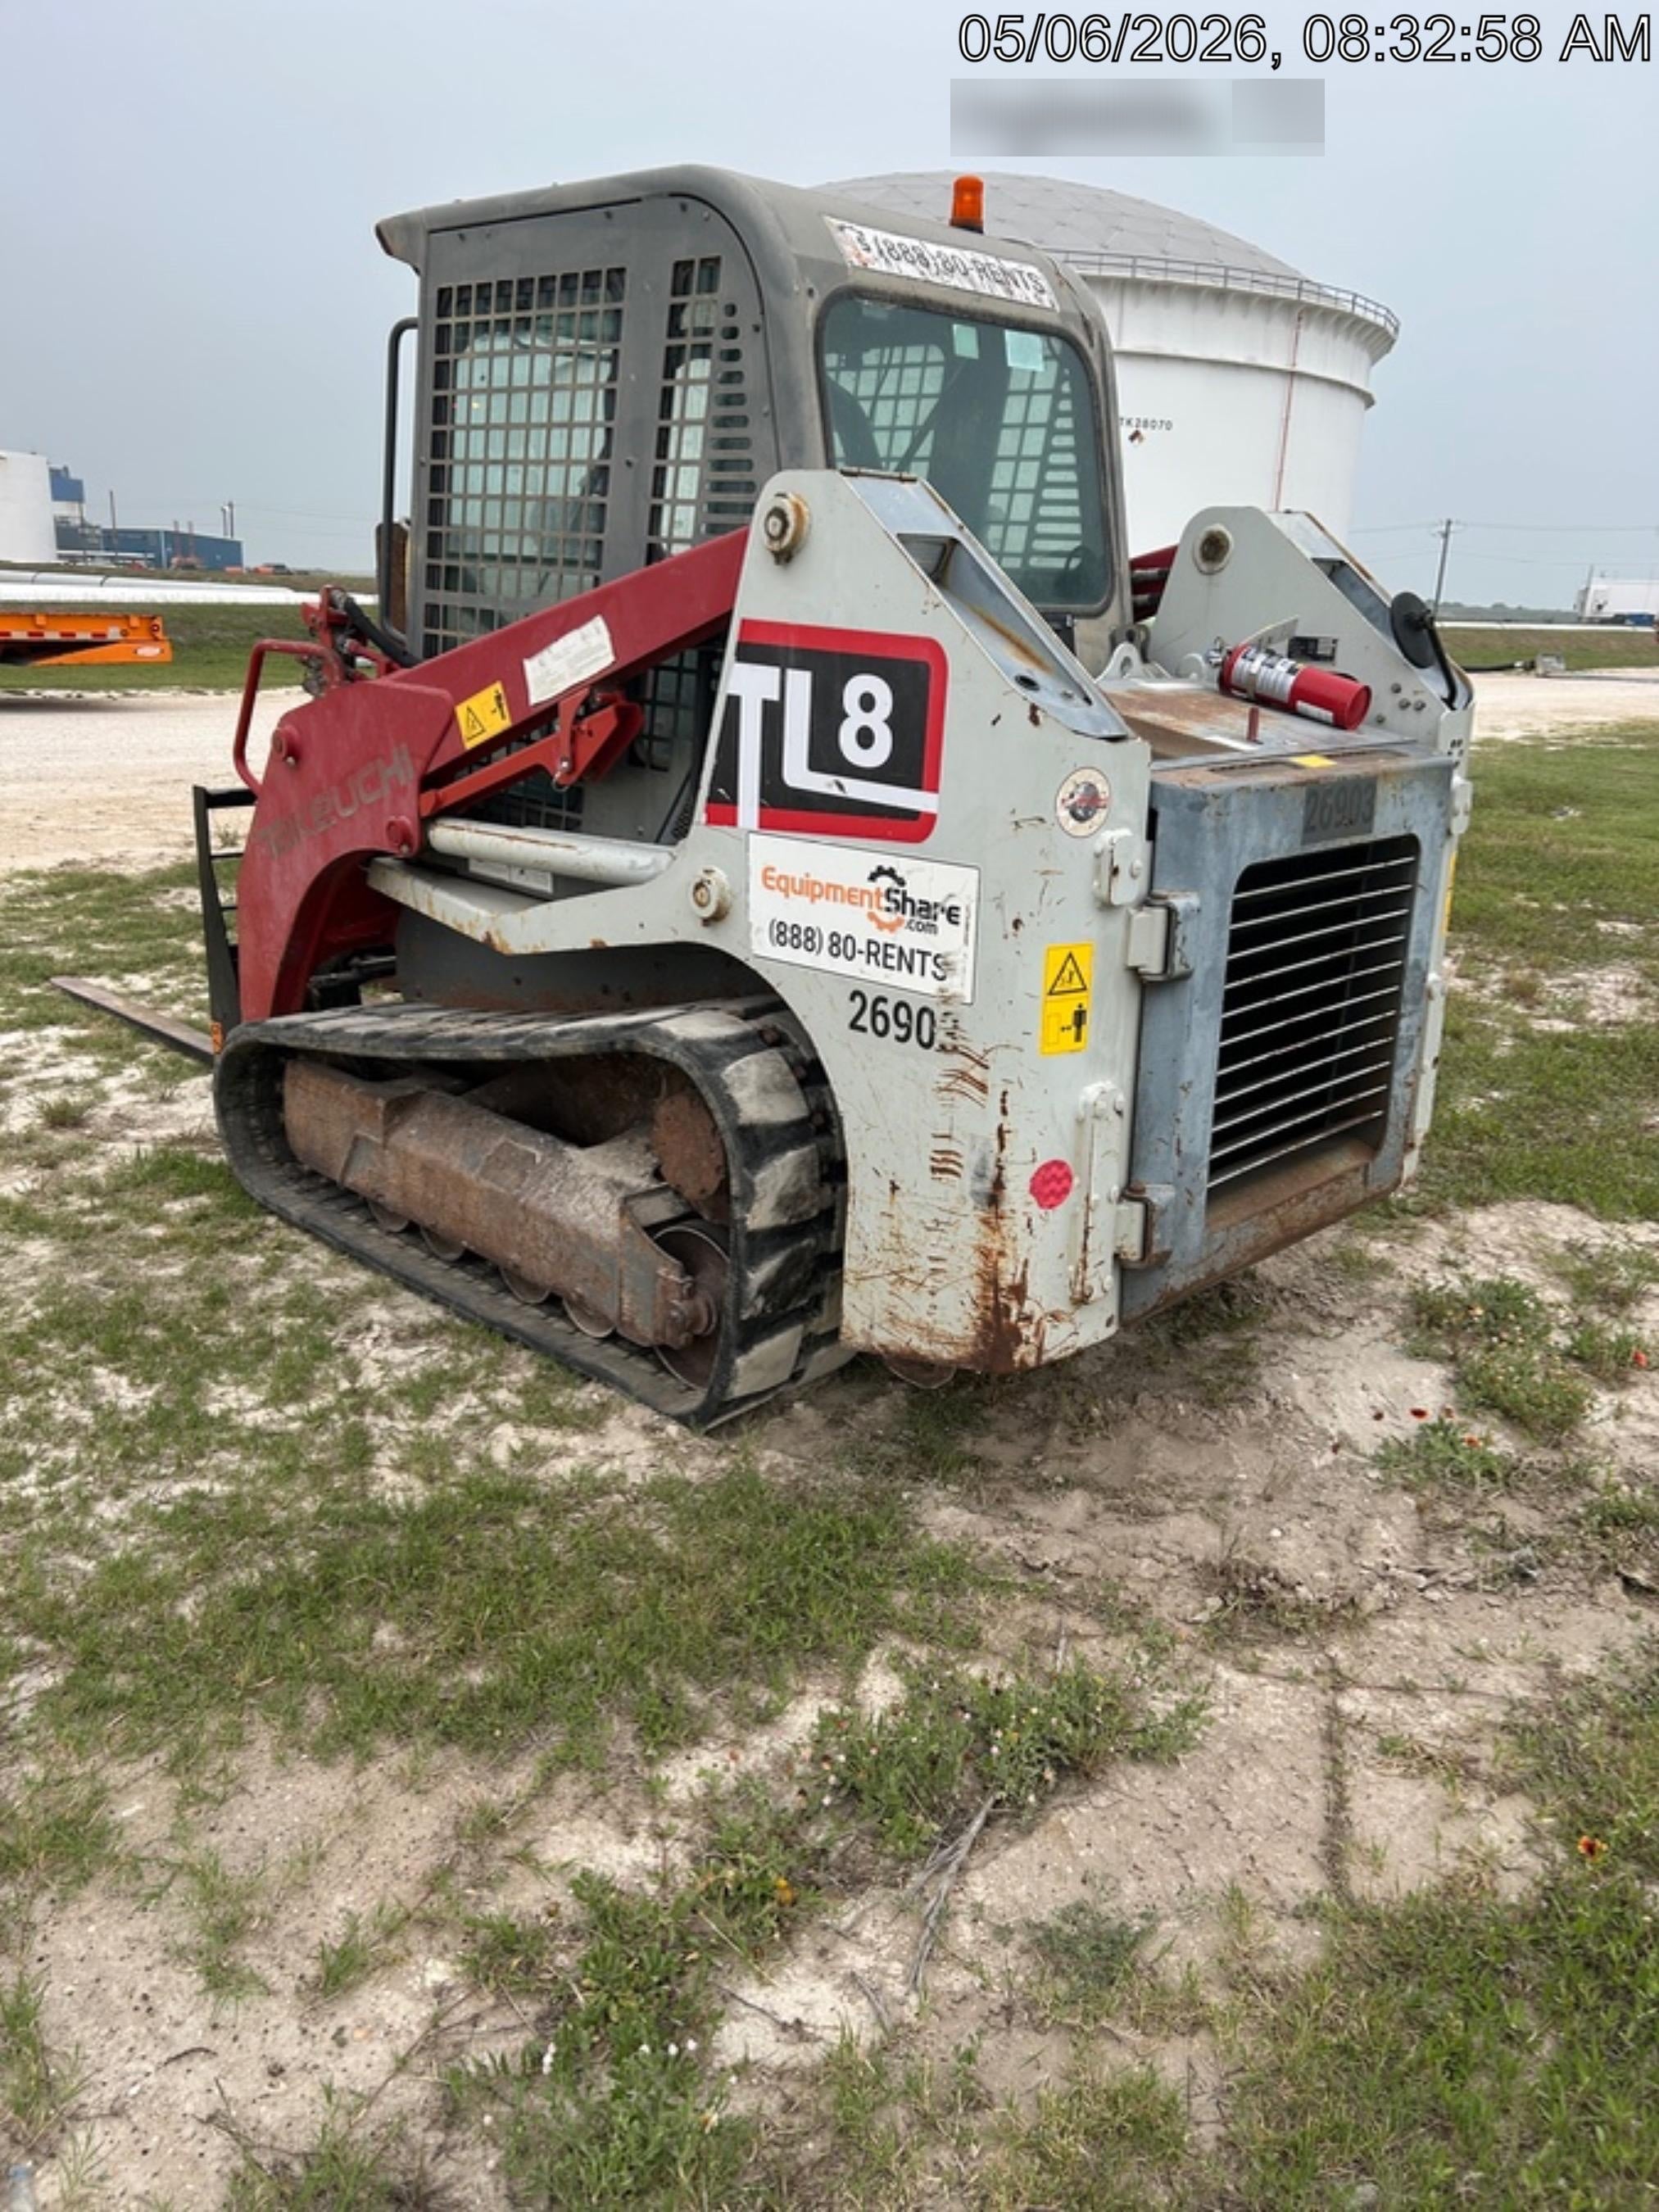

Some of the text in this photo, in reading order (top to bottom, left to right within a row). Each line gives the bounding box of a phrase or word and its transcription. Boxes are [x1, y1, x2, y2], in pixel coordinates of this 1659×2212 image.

[726, 662, 939, 829] TL8
[761, 864, 961, 926] EquipmentShare
[768, 918, 948, 981] (888) 80-RENTS
